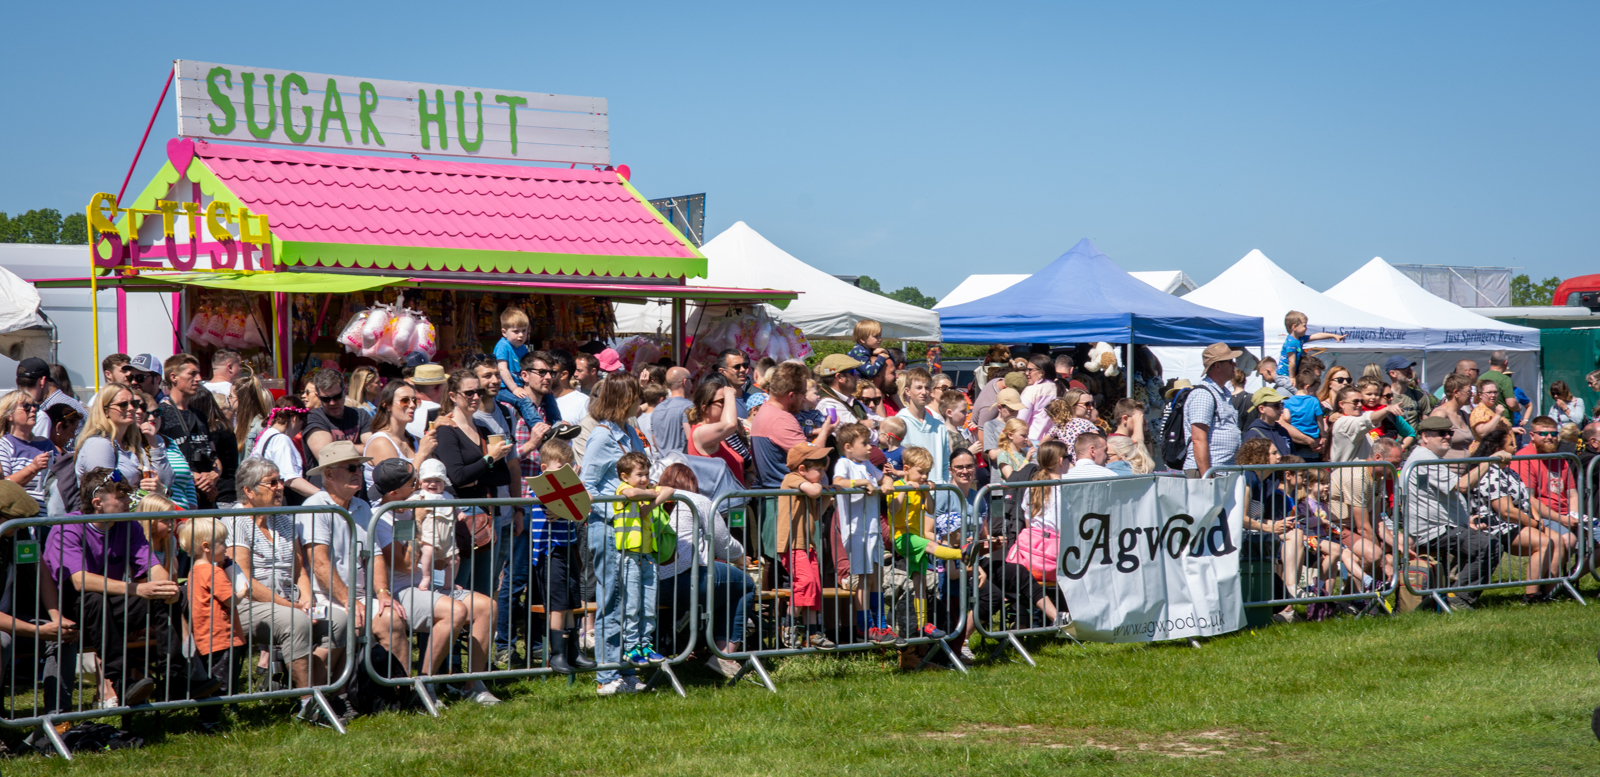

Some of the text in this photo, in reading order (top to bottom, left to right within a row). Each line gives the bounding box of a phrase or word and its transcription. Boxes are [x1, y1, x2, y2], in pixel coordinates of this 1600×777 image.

[206, 66, 528, 155] SUGAR HUT
[89, 192, 272, 274] SLUSH
[1379, 327, 1407, 341] Rescue
[1443, 330, 1524, 346] Just Springers Rescue
[1062, 508, 1237, 580] Agwood
